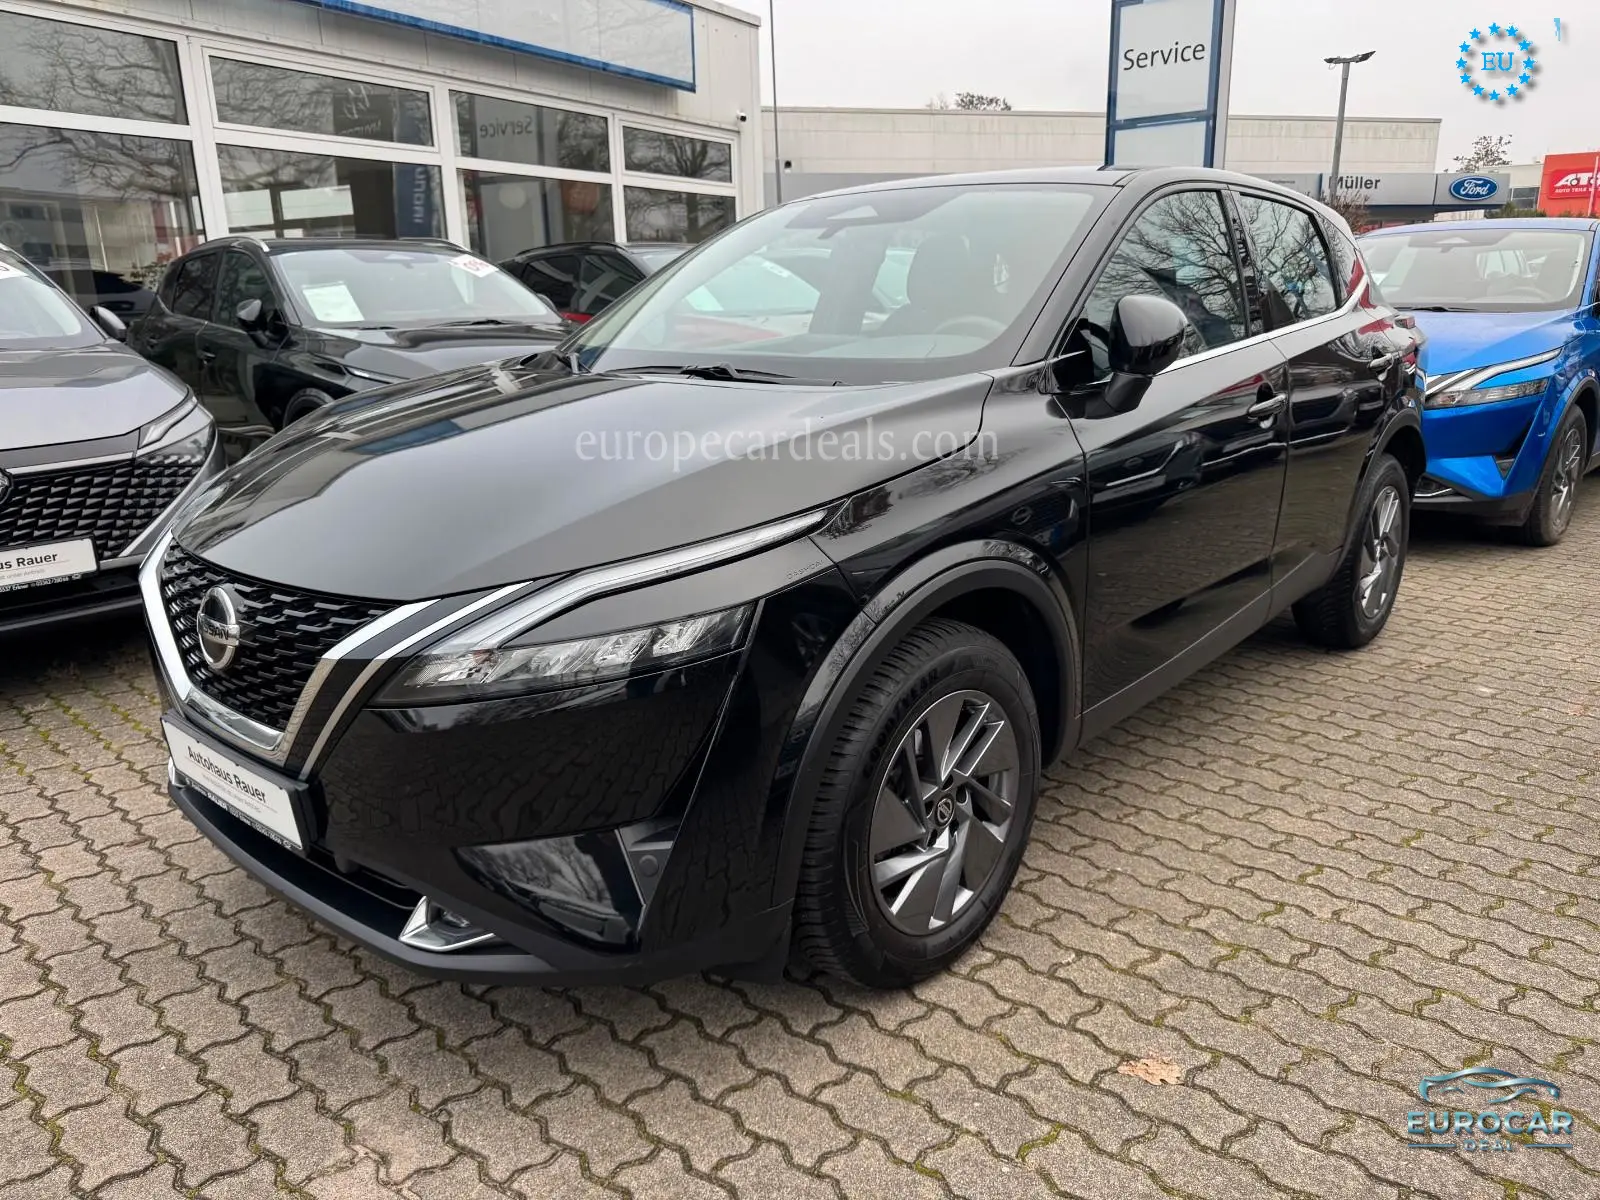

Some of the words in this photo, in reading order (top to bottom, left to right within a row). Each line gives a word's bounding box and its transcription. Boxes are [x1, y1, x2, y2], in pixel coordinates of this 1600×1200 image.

[1123, 41, 1206, 71] Service
[1460, 179, 1489, 195] Ford
[16, 553, 58, 567] Rauer
[187, 745, 233, 785] Autohaus
[233, 774, 267, 803] Rauer
